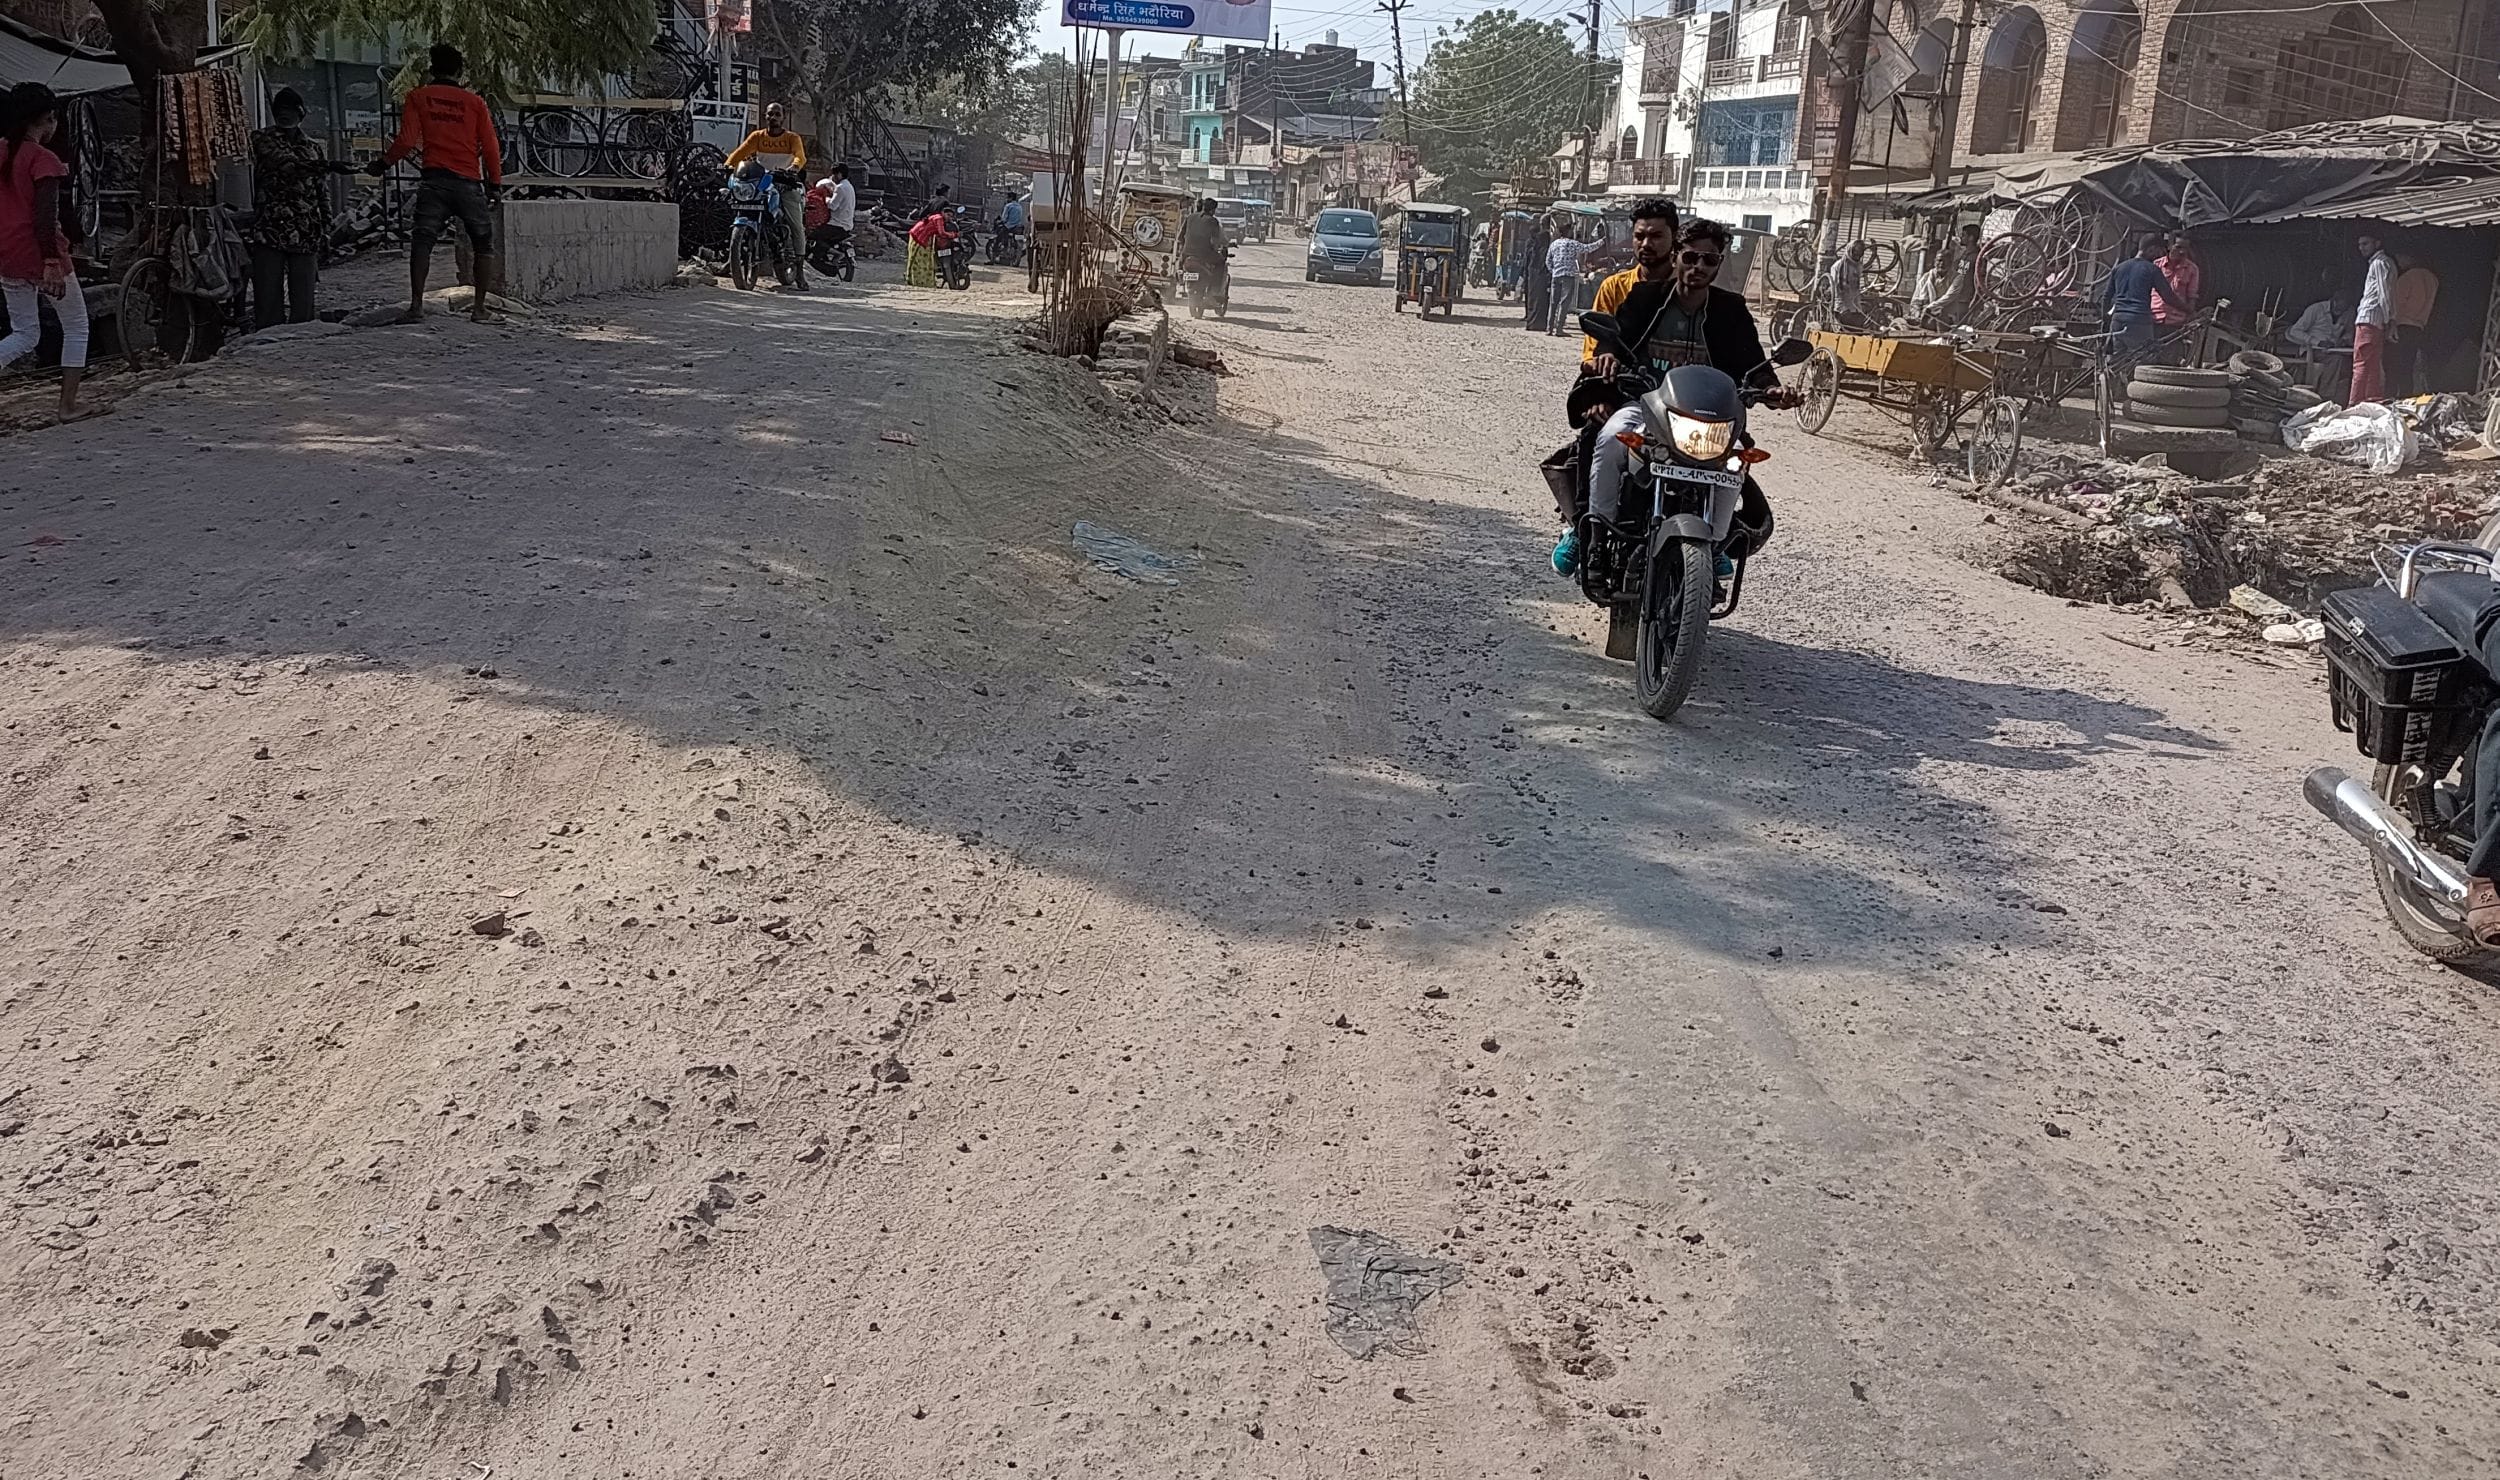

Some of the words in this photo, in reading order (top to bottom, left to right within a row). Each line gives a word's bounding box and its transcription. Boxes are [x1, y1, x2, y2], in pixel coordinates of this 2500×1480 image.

[1114, 2, 1135, 16] सिंह
[1139, 4, 1184, 20] भदौरिया
[761, 140, 787, 149] GUCCI
